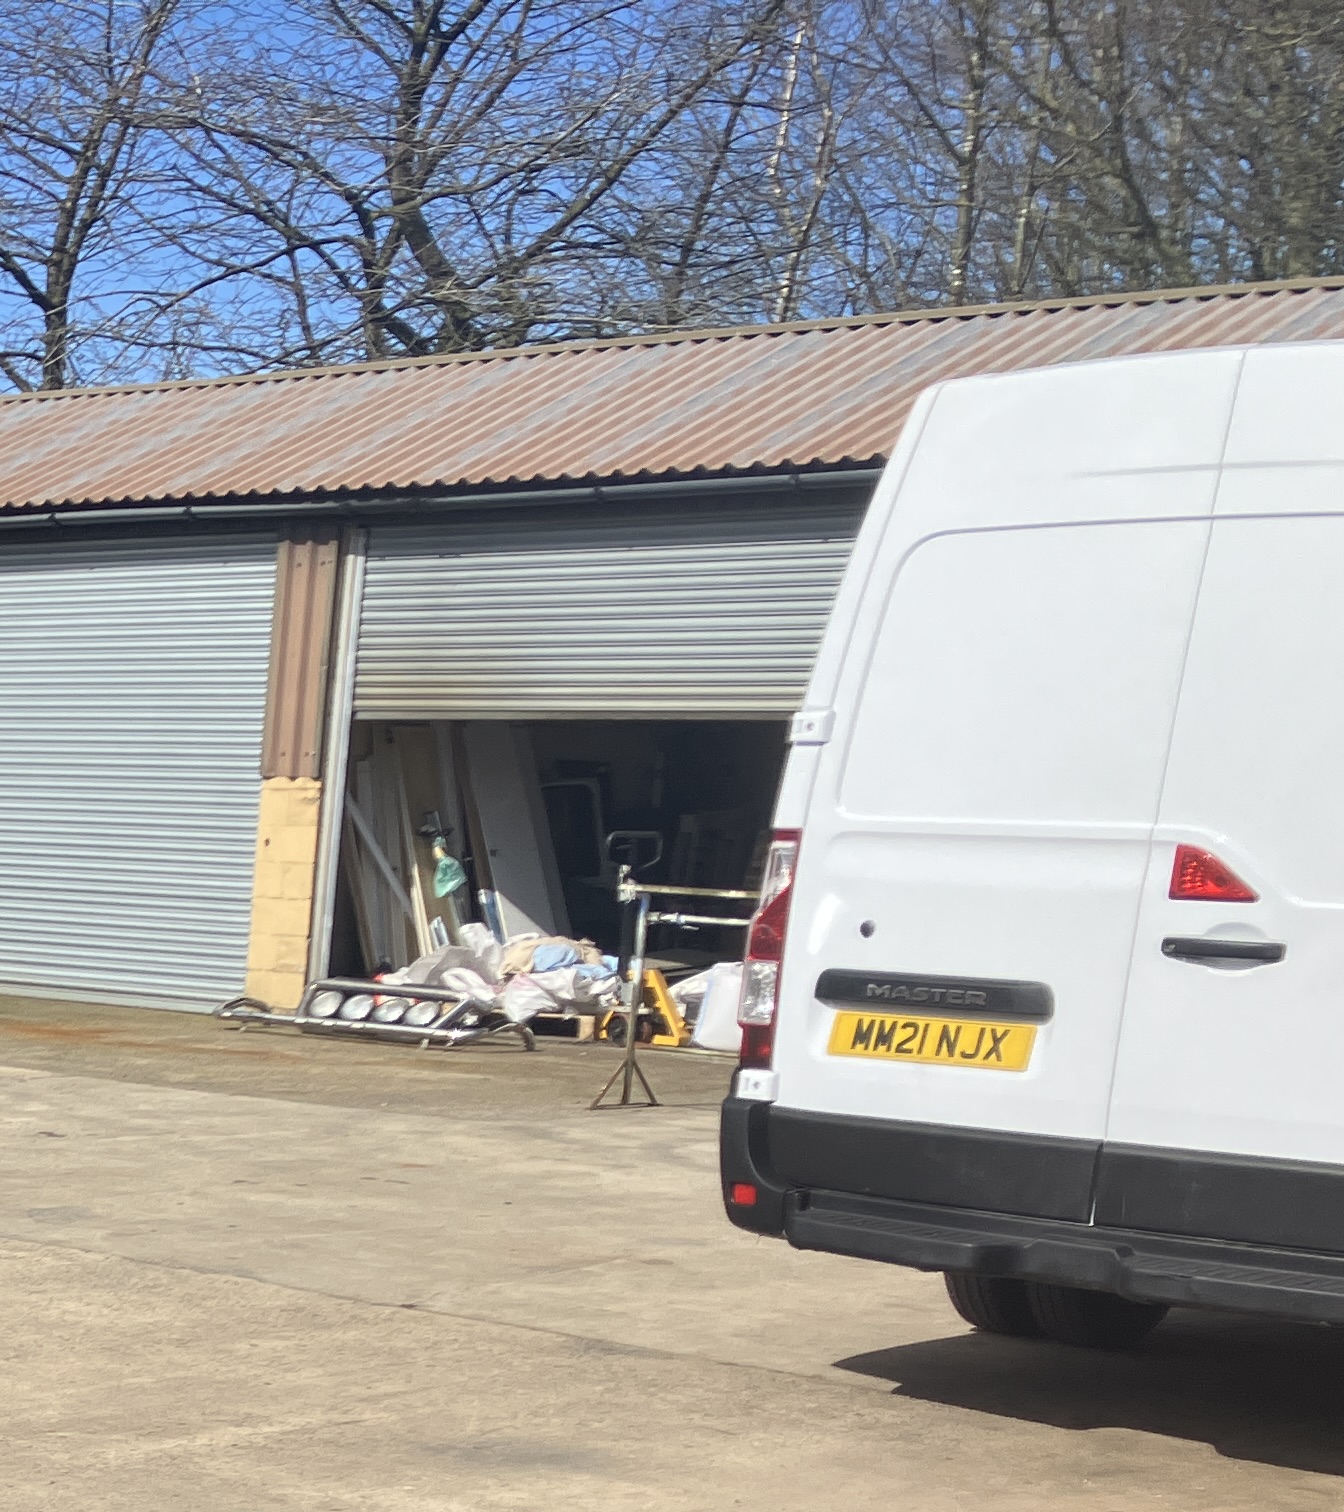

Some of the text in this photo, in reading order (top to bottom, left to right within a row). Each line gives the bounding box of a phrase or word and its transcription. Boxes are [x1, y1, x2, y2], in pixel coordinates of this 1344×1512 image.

[866, 983, 988, 1007] MASTER
[850, 1017, 1011, 1062] MM21 NJX
